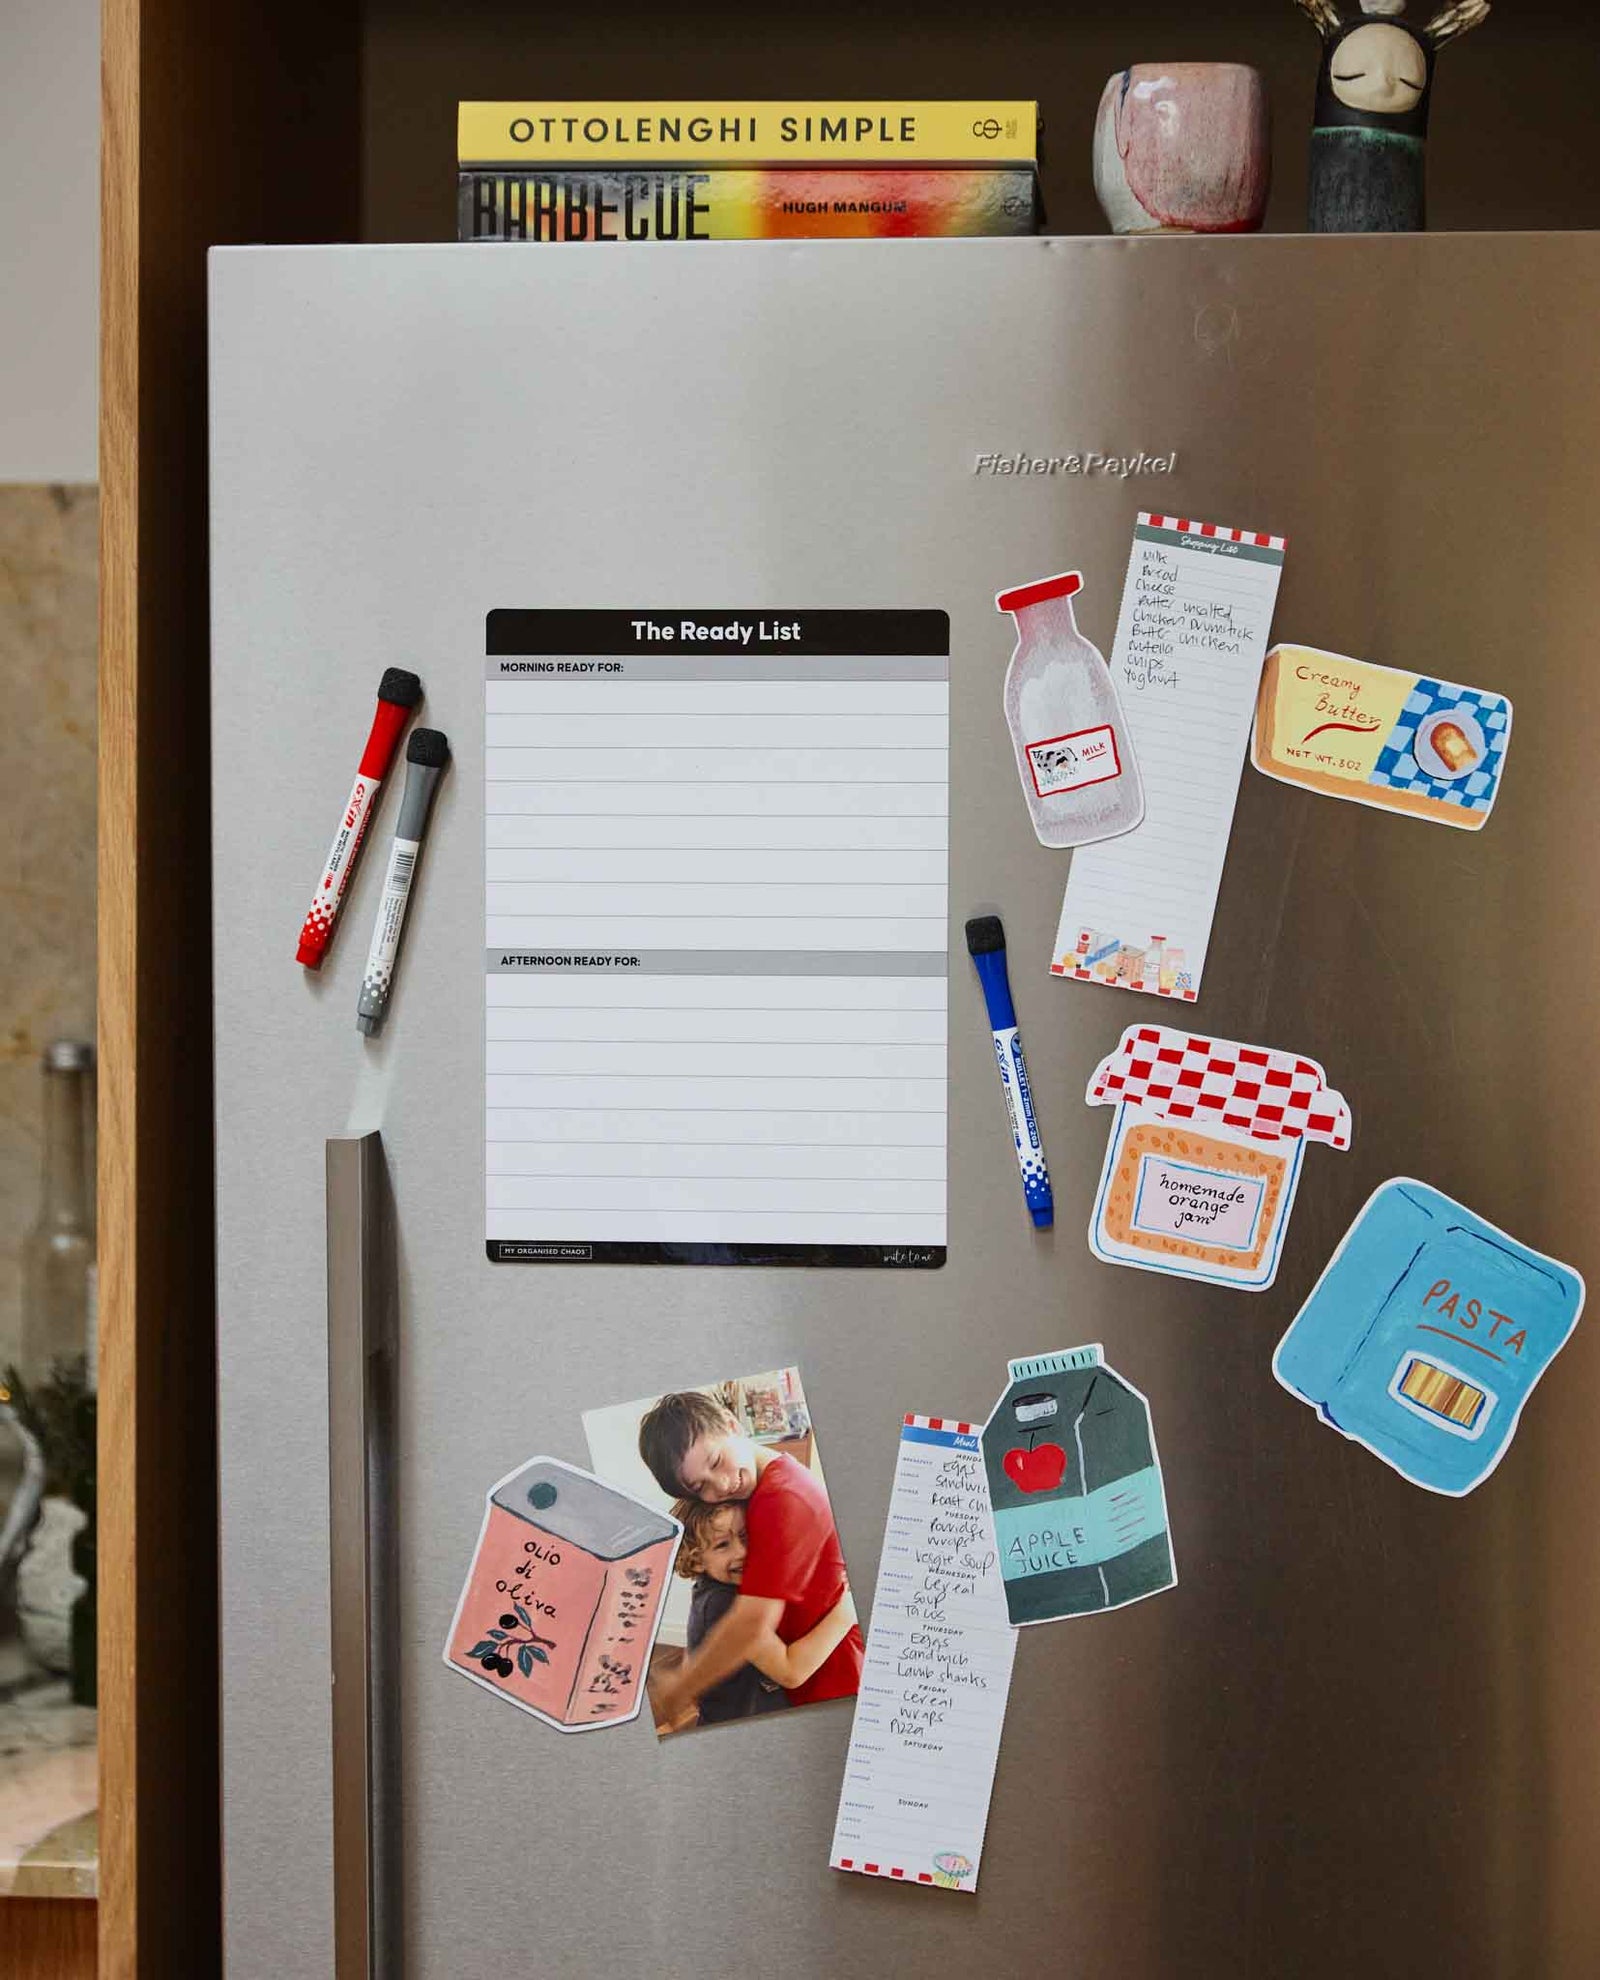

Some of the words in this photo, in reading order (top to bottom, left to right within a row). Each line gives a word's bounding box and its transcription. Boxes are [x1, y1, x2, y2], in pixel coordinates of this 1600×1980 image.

[509, 117, 757, 143] OTTOLENGHI
[781, 117, 916, 143] SIMPLE
[783, 202, 828, 214] HUGH
[975, 452, 1177, 479] Fisher&Paykel
[1135, 578, 1175, 595] Cheese
[631, 621, 675, 640] The
[680, 621, 753, 645] Ready
[759, 621, 801, 640] List
[500, 662, 555, 673] MORNING
[557, 662, 595, 673] READY
[597, 662, 624, 673] FOR:
[1295, 665, 1361, 700] Creamy
[1314, 693, 1382, 725] Butter
[1081, 742, 1105, 757] MILK
[1286, 747, 1311, 758] NET
[500, 956, 572, 966] AFTERNOON
[574, 956, 612, 966] READY
[614, 957, 641, 967] FOR:
[1160, 1173, 1245, 1203] homemade
[1168, 1194, 1229, 1221] orange
[1174, 1210, 1211, 1228] jam
[1422, 1279, 1527, 1355] PASTA
[1009, 1527, 1088, 1556] APPLE
[515, 1560, 536, 1579] di
[1015, 1550, 1079, 1574] JUICE
[918, 1684, 947, 1694] FRIDAY
[903, 1739, 944, 1751] SATURDAY
[898, 1798, 929, 1809] SUNDAY
